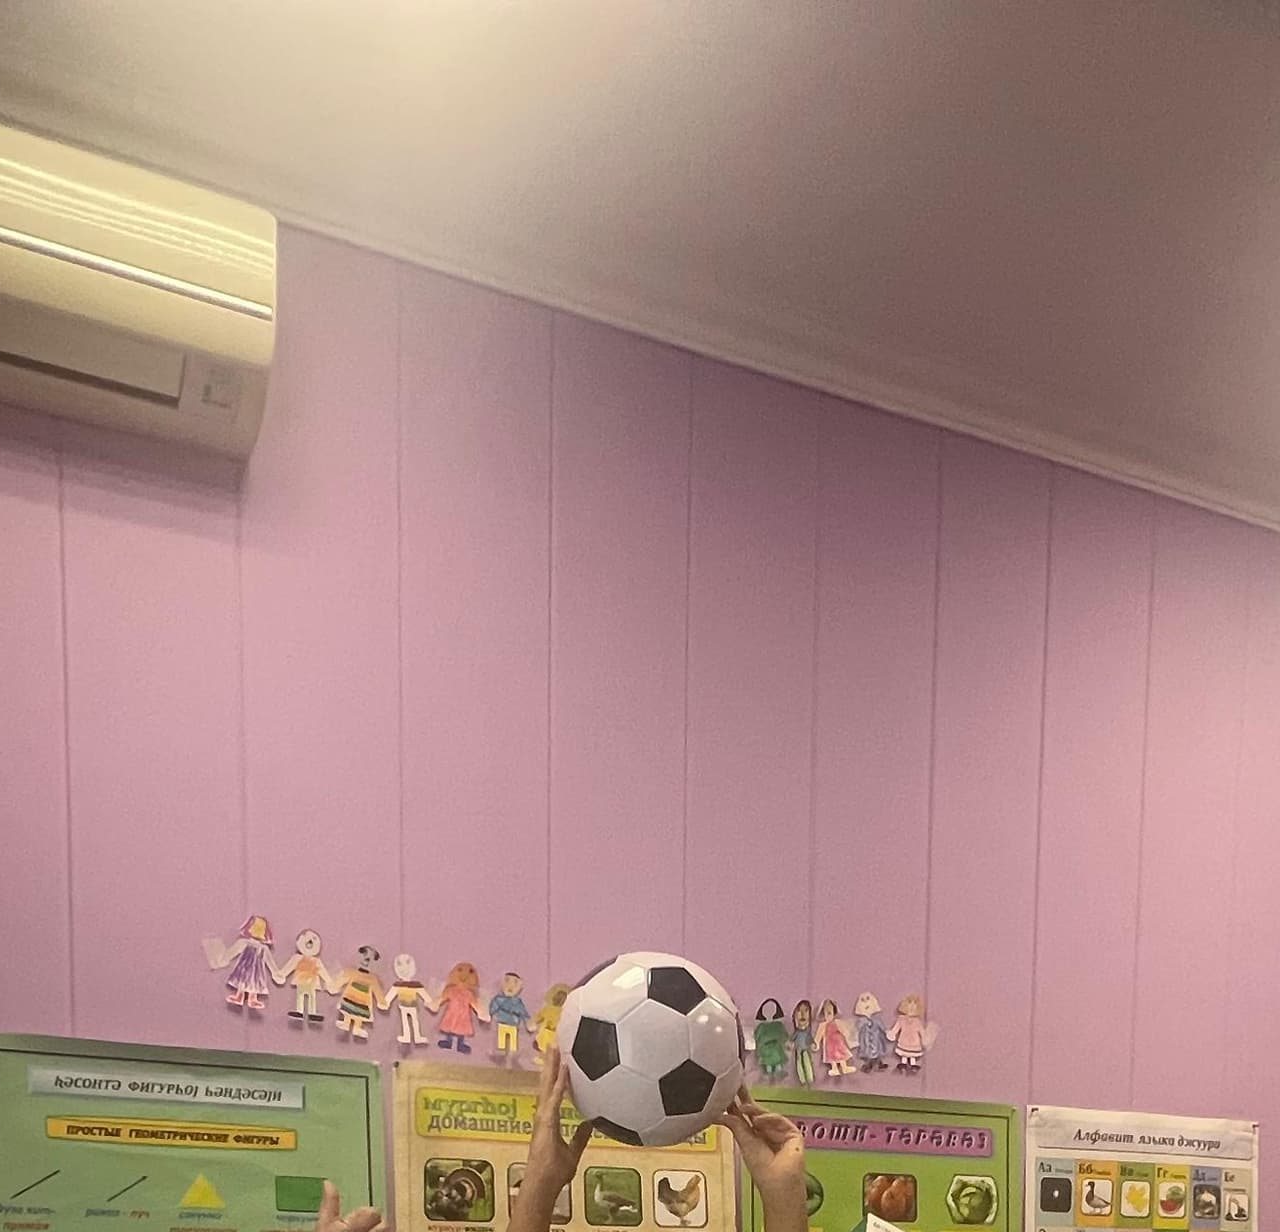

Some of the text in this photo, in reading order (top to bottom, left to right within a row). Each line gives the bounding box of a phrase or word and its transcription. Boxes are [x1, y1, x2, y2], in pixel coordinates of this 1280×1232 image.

[428, 1114, 532, 1134] домашние
[66, 1125, 280, 1145] ПРОСТЫЕ ГЕОМЕТРИЧЕСКИЕ ФИГУРЫ
[1073, 1128, 1134, 1146] Алфавит
[1138, 1135, 1175, 1147] языка
[1038, 1161, 1052, 1174] Аа
[1078, 1164, 1094, 1176] Бб
[1156, 1167, 1169, 1179] Гг
